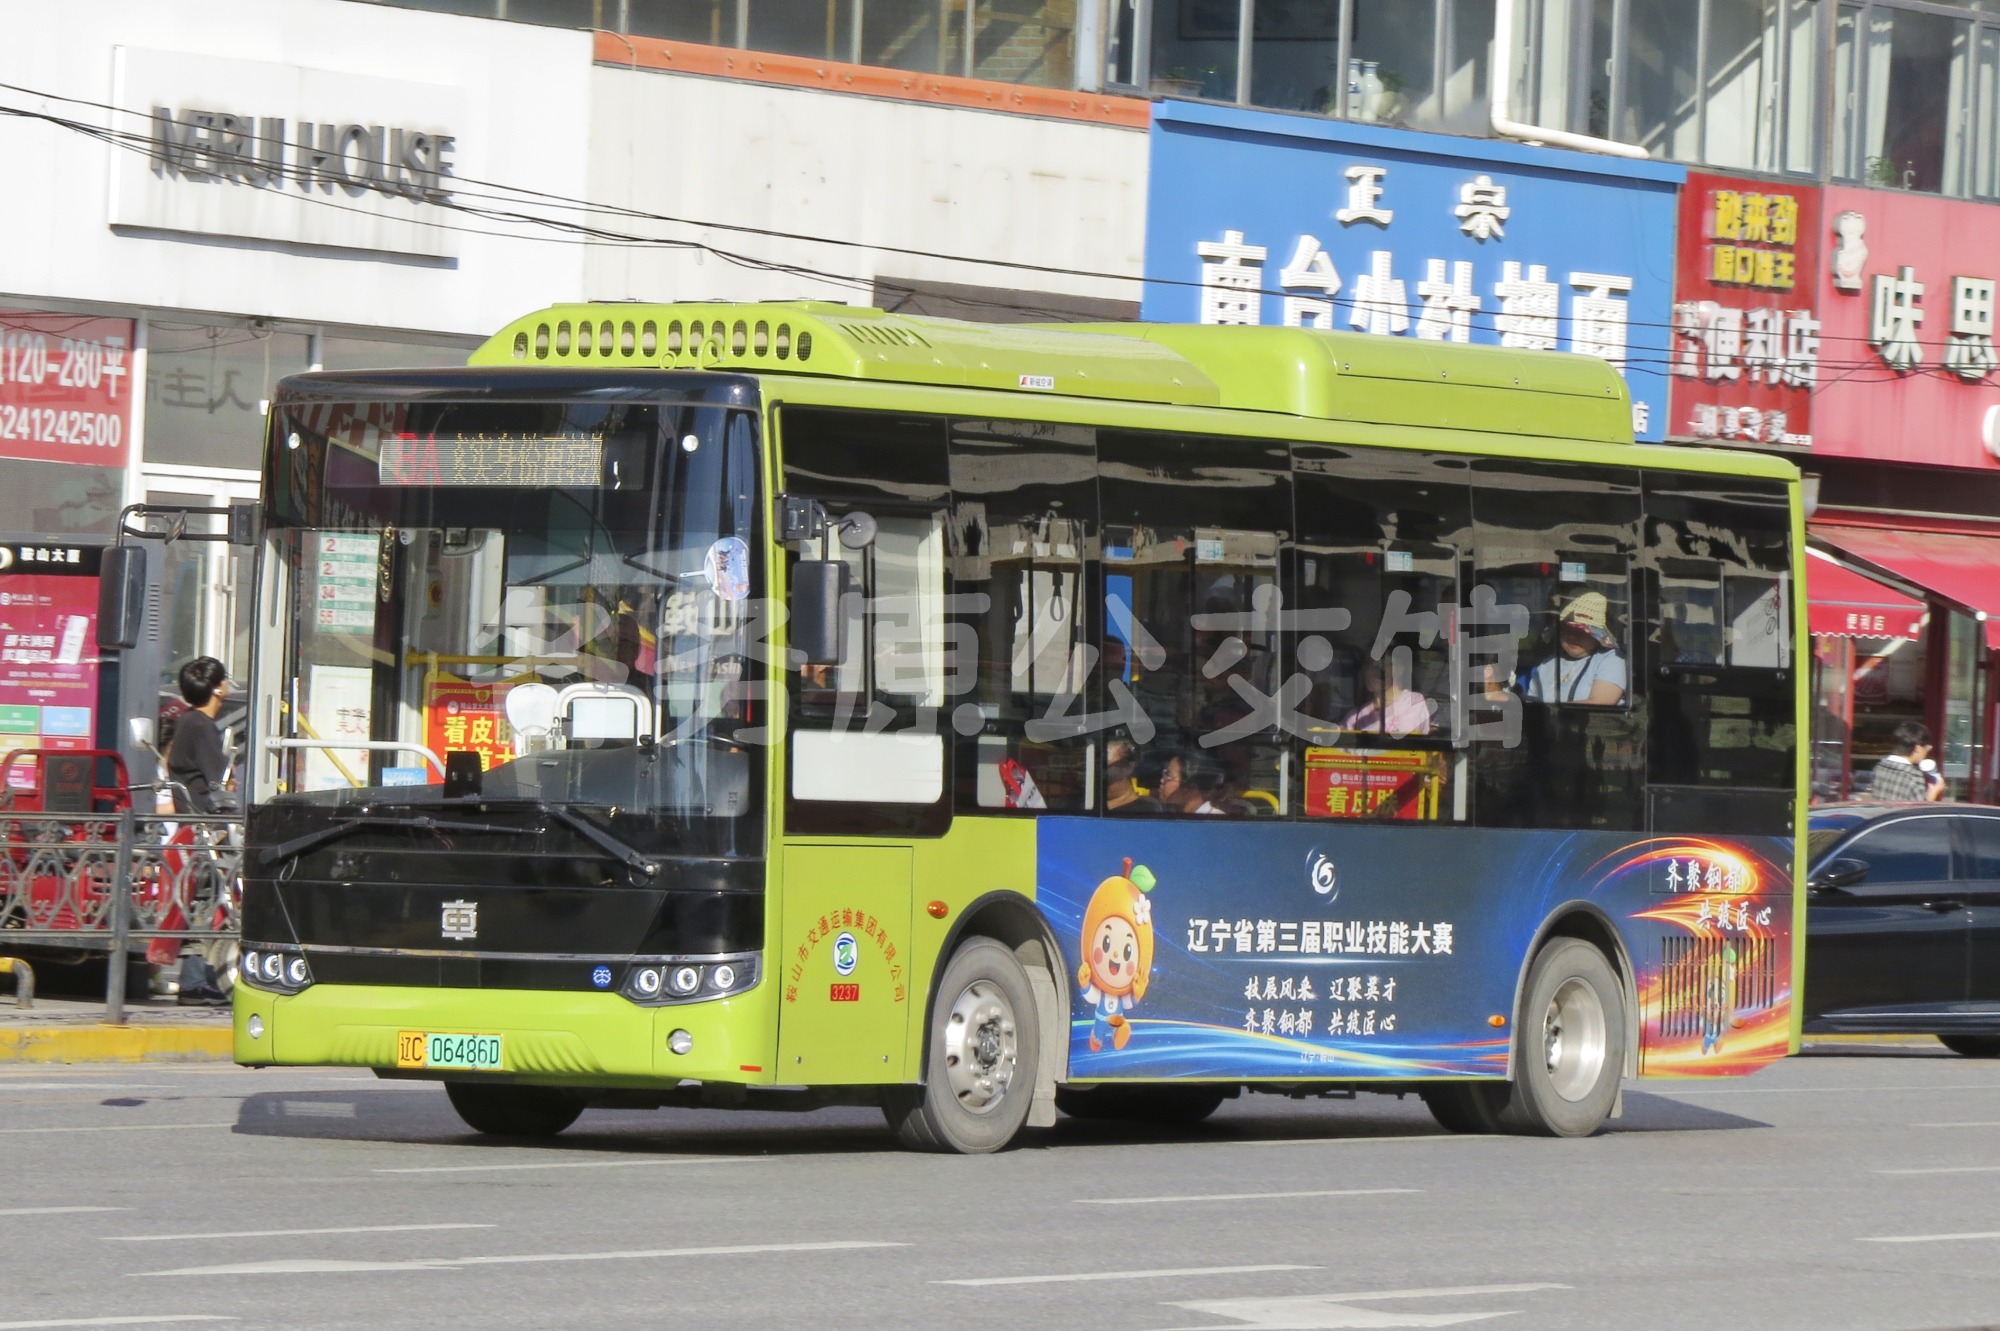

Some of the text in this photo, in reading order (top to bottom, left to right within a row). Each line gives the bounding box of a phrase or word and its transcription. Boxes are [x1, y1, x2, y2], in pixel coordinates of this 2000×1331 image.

[296, 121, 456, 204] HOUSE
[1336, 165, 1511, 240] 正宗
[1702, 302, 1821, 387] 便利店
[1868, 265, 1999, 379] 味思
[0, 328, 127, 398] 120-280平
[0, 404, 122, 448] 241242500
[1846, 612, 1885, 631] 便利店
[786, 908, 904, 1003] 鞍山市交通运输集团有限公司
[1187, 919, 1453, 955] 辽宁省第三届职业技能大赛
[831, 985, 858, 1001] 3237
[432, 1037, 499, 1065] 06486D
